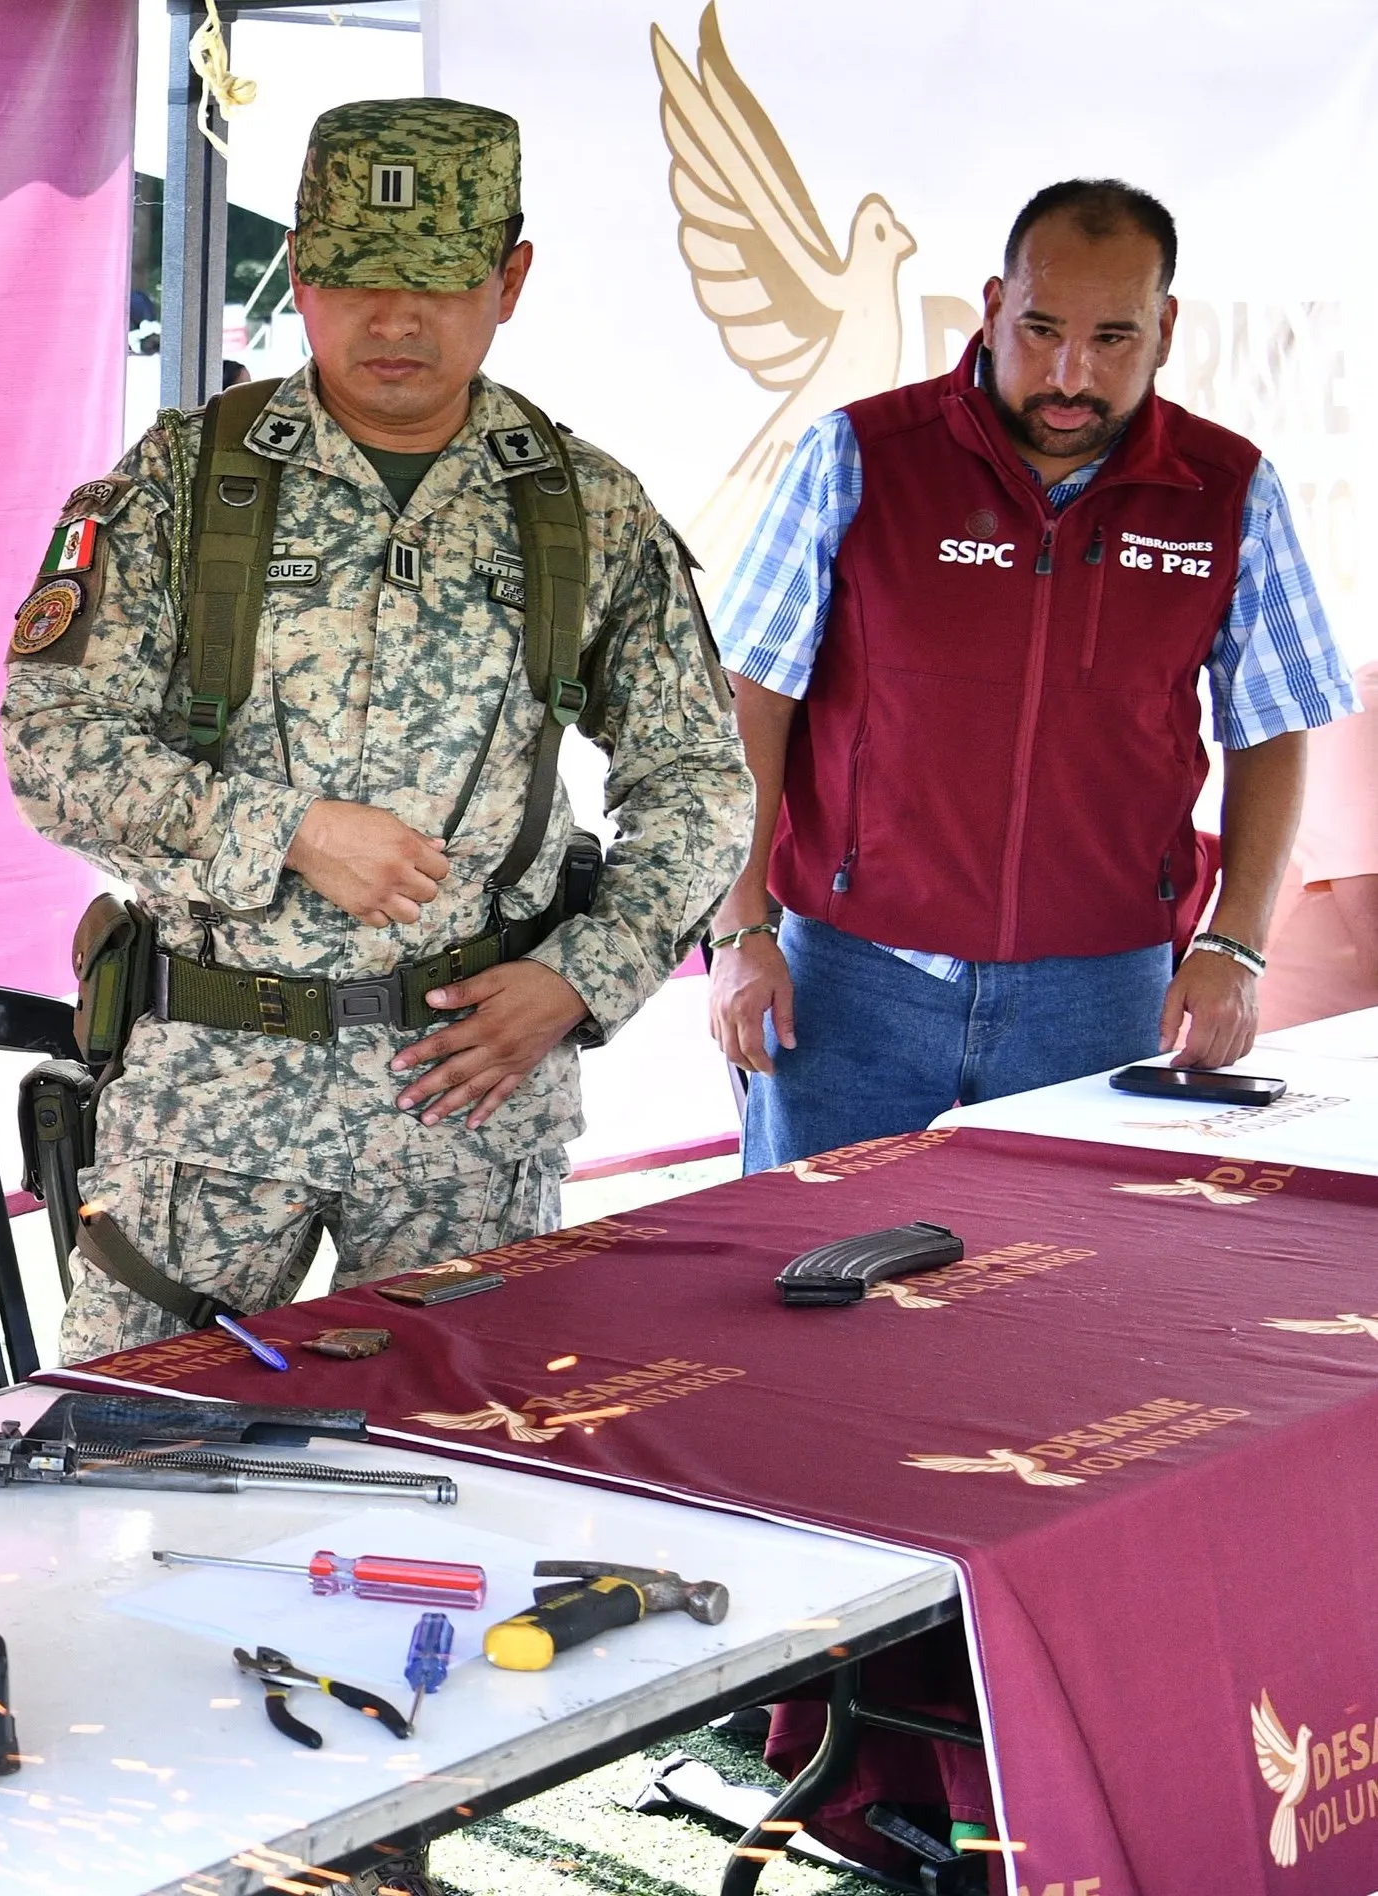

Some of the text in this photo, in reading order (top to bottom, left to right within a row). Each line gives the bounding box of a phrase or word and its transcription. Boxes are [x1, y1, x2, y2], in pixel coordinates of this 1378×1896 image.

[938, 538, 1016, 568] SSPC
[1121, 532, 1214, 552] SEMBRADORES
[1119, 546, 1212, 578] de Paz
[1024, 1397, 1205, 1460] DESARME
[1057, 1406, 1252, 1476] VOLUNTARIO
